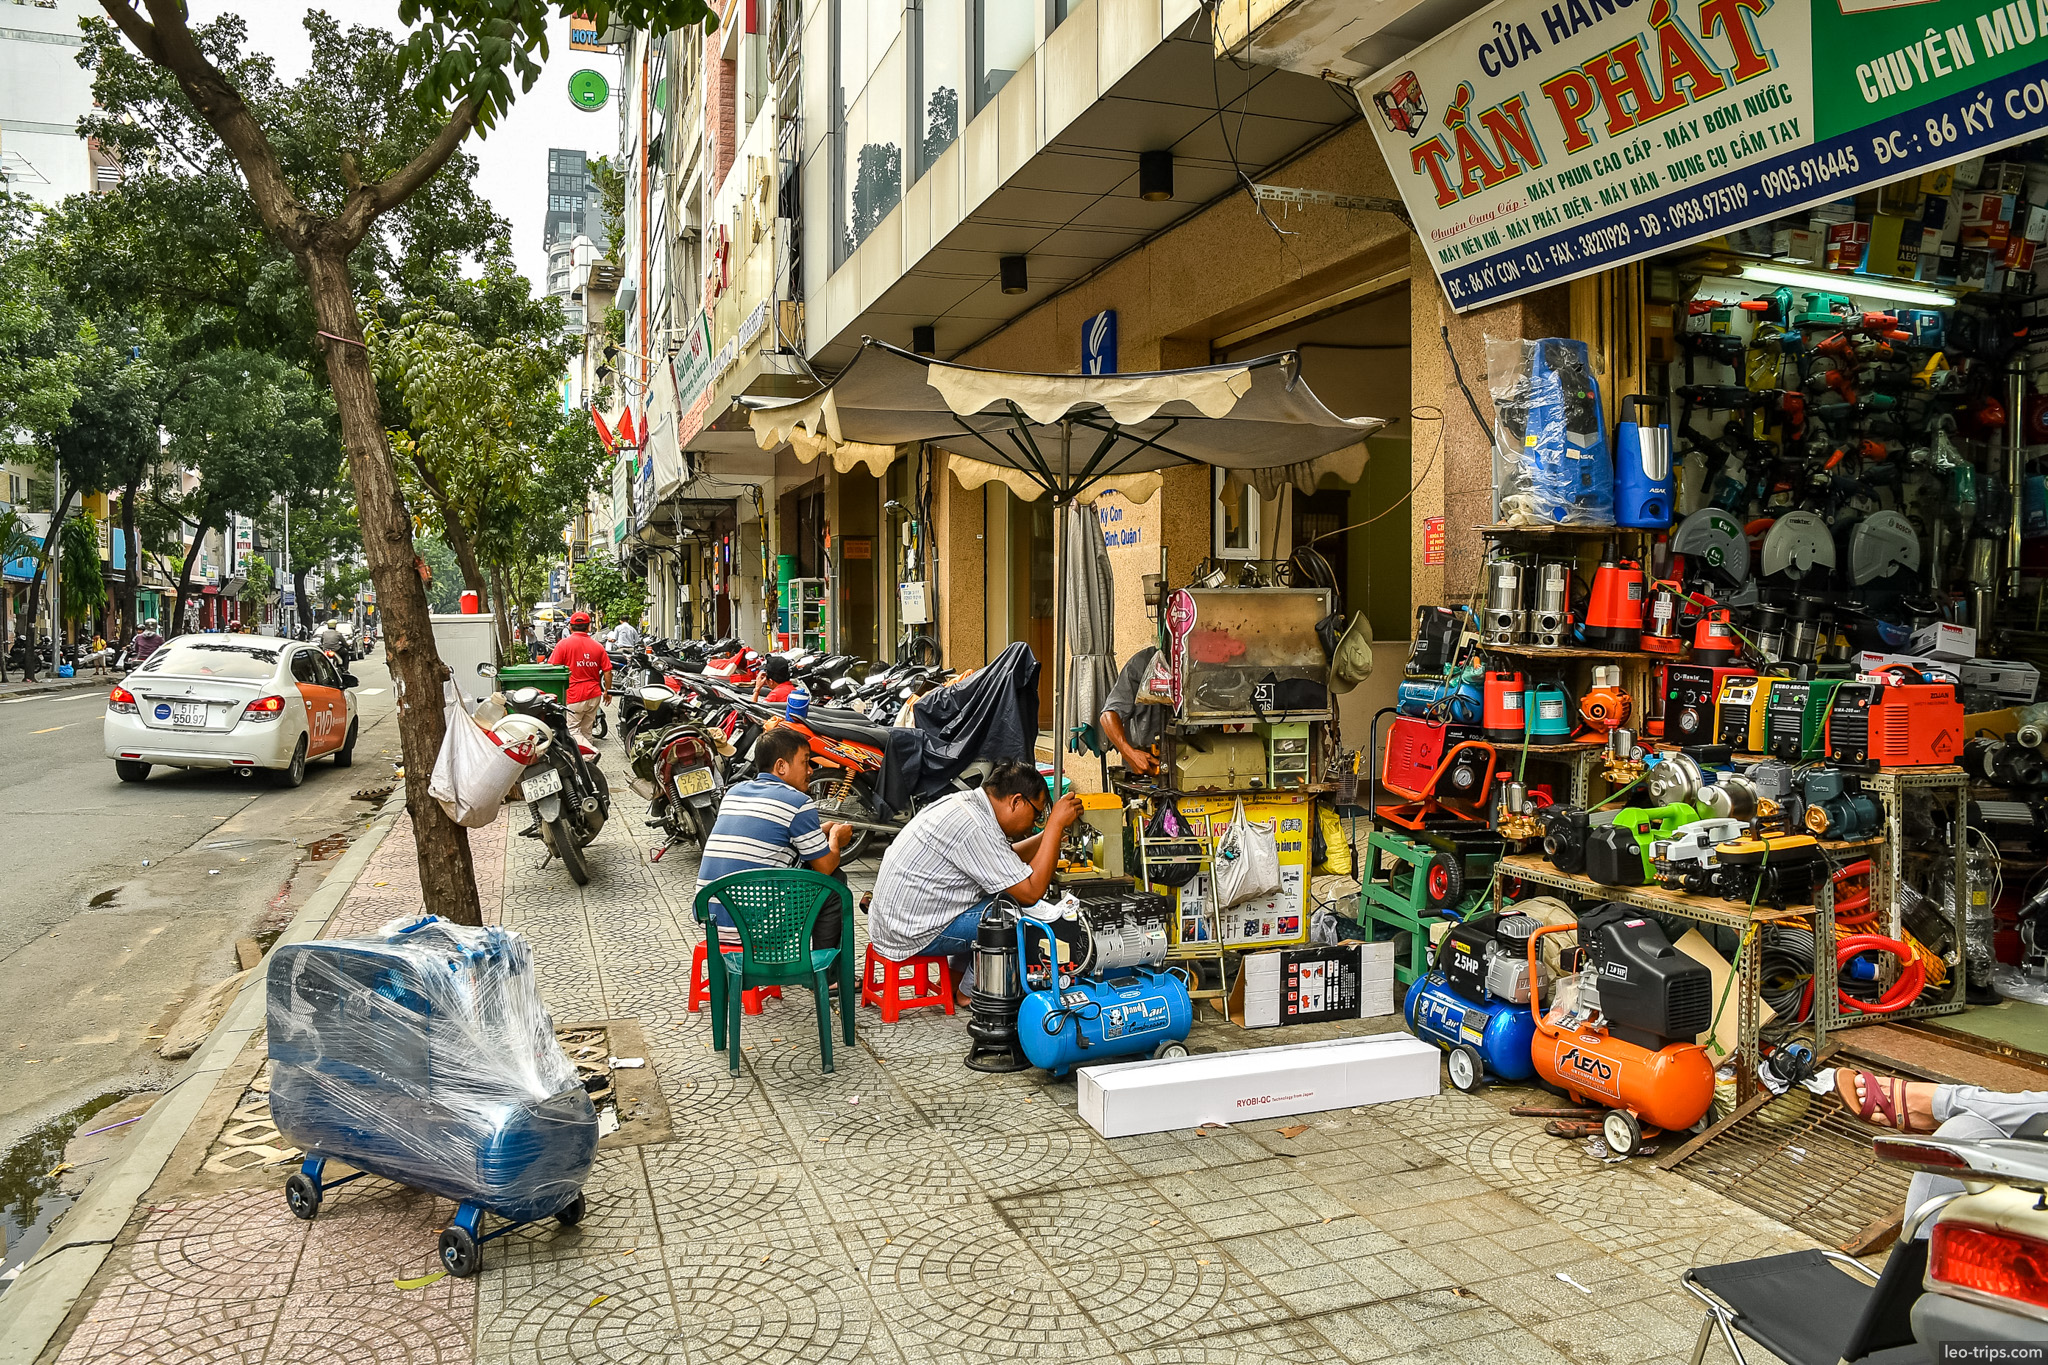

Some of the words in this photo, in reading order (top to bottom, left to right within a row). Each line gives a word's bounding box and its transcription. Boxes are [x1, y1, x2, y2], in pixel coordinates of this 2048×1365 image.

[1478, 21, 1542, 78] CỬA
[1855, 27, 1976, 104] CHUYÊN
[1409, 80, 1547, 210] TẤN
[1539, 0, 1774, 155] PHÁT
[1431, 220, 1467, 241] Chuyên
[1468, 210, 1496, 226] Cung
[1497, 200, 1521, 216] Cấp
[1526, 176, 1556, 202] MÁY
[1557, 163, 1593, 190] PHUN
[1593, 151, 1624, 177] CAO
[1623, 137, 1653, 166] CẤP
[1663, 121, 1700, 150] MÁY
[1703, 102, 1743, 134] BƠM
[1743, 83, 1793, 119] NƯỚC
[1438, 242, 1462, 264] MÁY
[1461, 233, 1483, 258] NÉN
[1482, 226, 1501, 250] KHÍ
[1505, 216, 1531, 241] MÁY
[1532, 206, 1561, 232] PHÁT
[1562, 196, 1593, 220] ĐIỆN
[1599, 182, 1632, 207] MÁY
[1630, 170, 1660, 196] HÀN
[1666, 154, 1704, 183] DỤNG
[1706, 145, 1728, 169] CỤ
[1729, 129, 1768, 161] CẦM
[1768, 117, 1801, 144] TAY
[1448, 277, 1466, 299] ĐC
[1470, 271, 1484, 294] 86
[1483, 261, 1497, 290] KÝ
[1496, 259, 1521, 284] CON
[1525, 250, 1544, 274] Q.1
[1549, 241, 1575, 267] FAX
[1578, 221, 1631, 257] 38211929
[1639, 213, 1662, 238] DĐ
[1669, 182, 1749, 230] 0938.975119
[1760, 146, 1860, 199] 0905.916445
[1872, 130, 1908, 165] ĐC
[1925, 113, 1958, 148] 86
[1960, 90, 1994, 136] KÝ
[1899, 253, 1917, 262] AEG
[1109, 505, 1122, 522] Con
[173, 714, 205, 726] 550.97
[181, 704, 198, 716] 51F
[1236, 1095, 1271, 1108] RYOBI-QC
